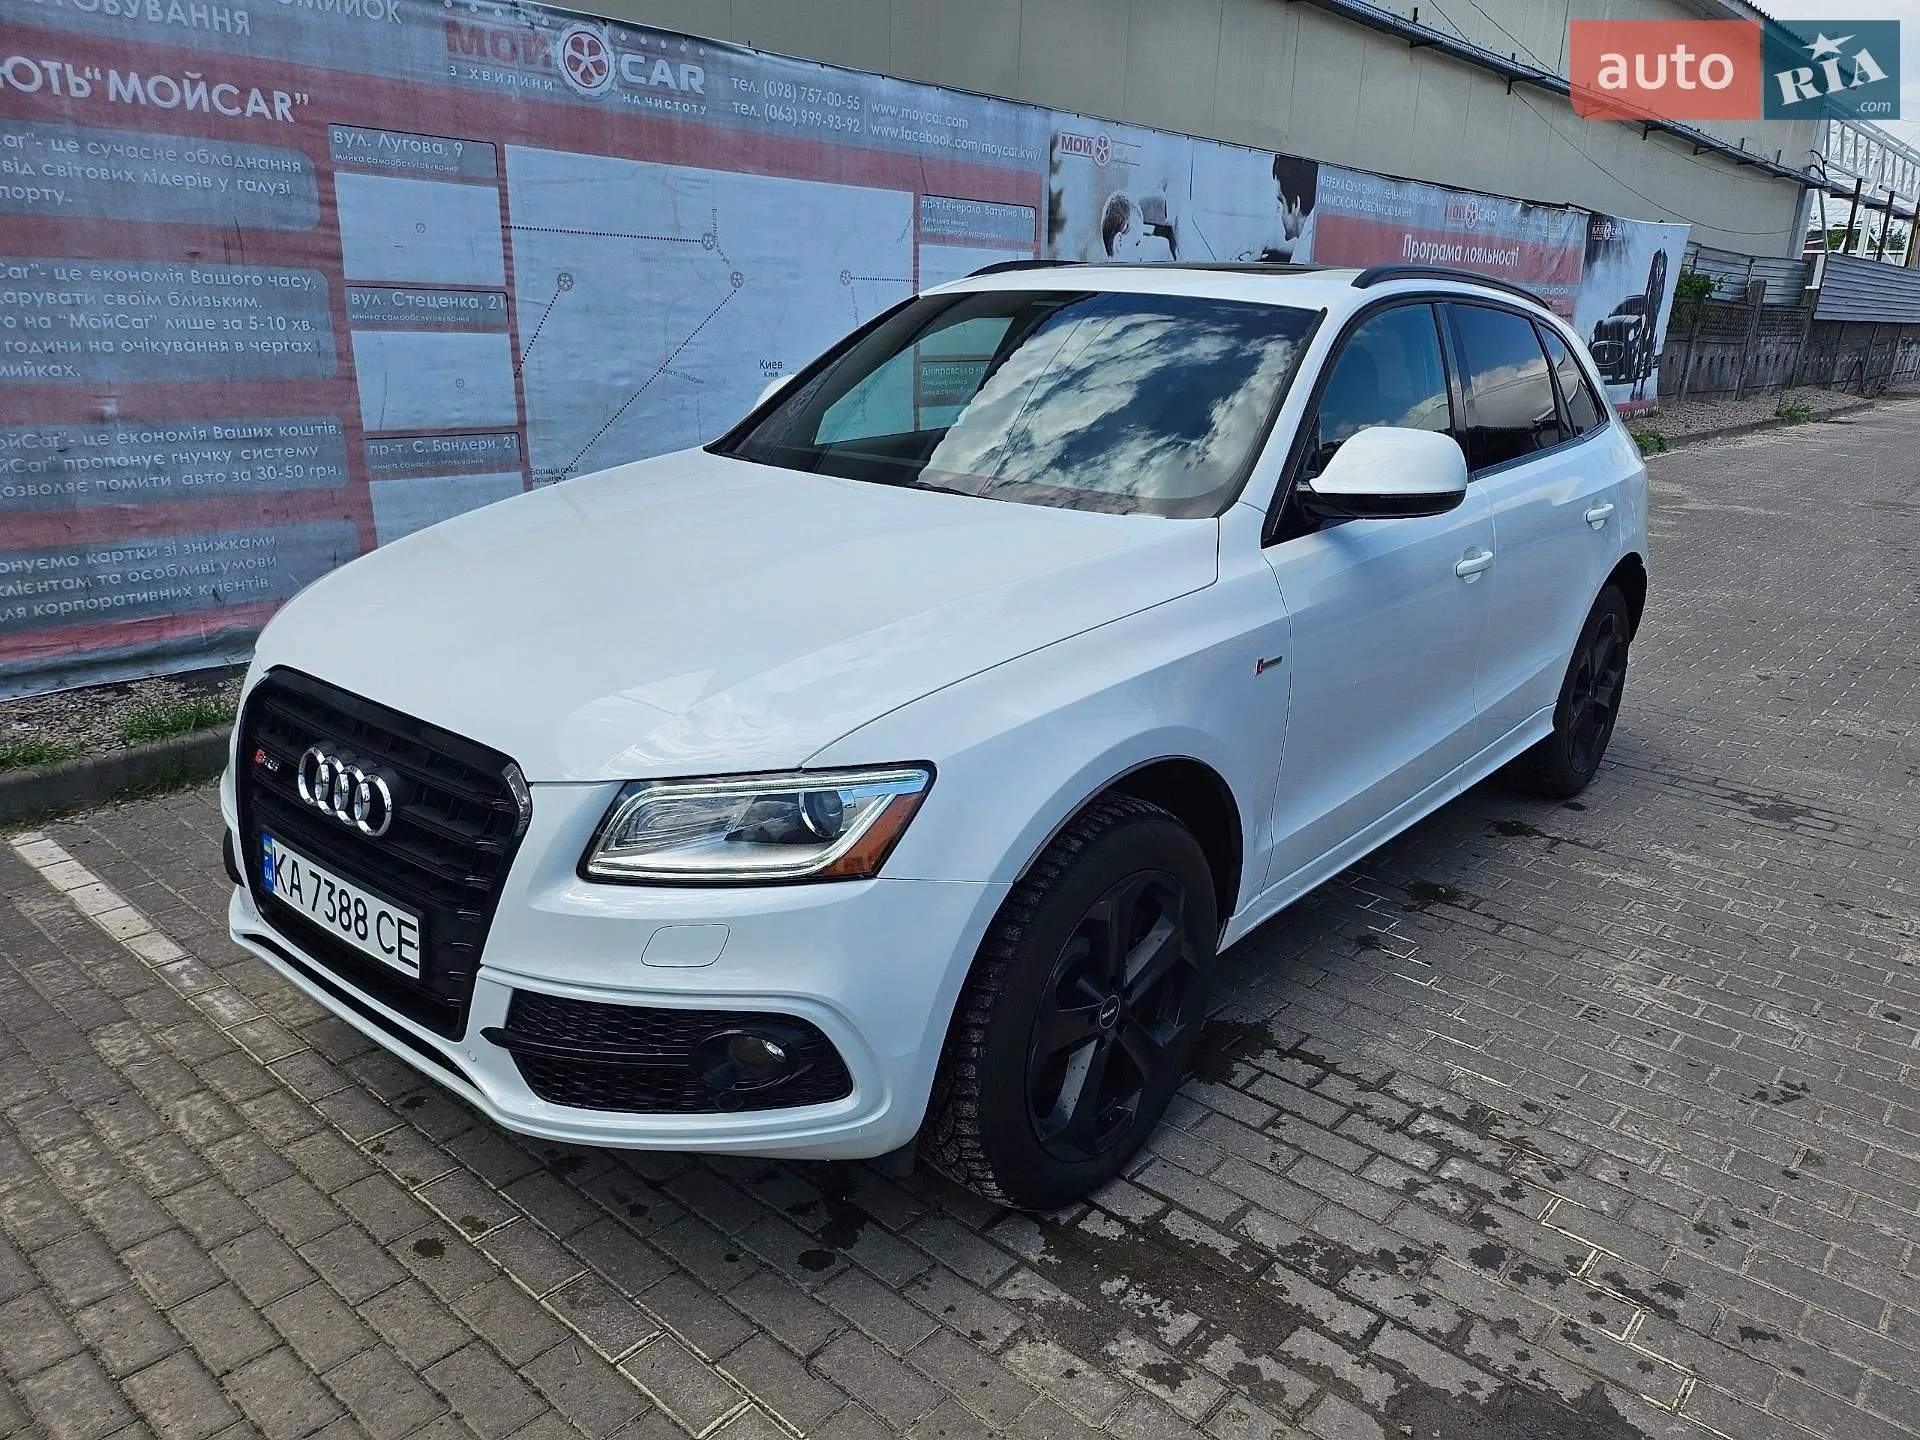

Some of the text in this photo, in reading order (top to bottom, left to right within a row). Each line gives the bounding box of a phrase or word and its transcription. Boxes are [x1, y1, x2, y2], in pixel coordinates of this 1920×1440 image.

[470, 69, 553, 92] ХВИЛИНИ
[620, 53, 706, 95] CAR
[622, 93, 708, 115] НА ЧИСТОТУ
[731, 77, 861, 111] тел. (098) 757-00-55
[732, 101, 861, 134] тел. (063) 999-93-92
[50, 139, 80, 154] це
[87, 141, 178, 162] сучасне
[184, 149, 302, 174] обладнання
[333, 131, 464, 158] вул. Лугова, 9
[335, 153, 365, 164] мийка
[2, 157, 291, 197] від світових лідерів у галузі
[1402, 233, 1520, 266] Програма лояльності
[54, 267, 83, 283] це
[90, 268, 184, 285] економія
[190, 269, 263, 288] Вашого
[268, 277, 317, 291] часу,
[0, 290, 263, 308] арувати своїм близьким.
[351, 291, 505, 310] вул. Стеценка, 21
[25, 316, 52, 328] на
[165, 316, 217, 330] лише
[223, 318, 243, 330] за
[249, 316, 287, 331] 5-10
[292, 320, 316, 331] хв.
[4, 337, 313, 356] години на очікування в чергах
[759, 359, 783, 370] Киев
[83, 434, 110, 447] це
[117, 427, 207, 445] економія
[213, 426, 274, 440] Ваших
[279, 421, 342, 437] коштів.
[412, 440, 429, 454] С.
[433, 438, 500, 452] Бандери,
[503, 435, 517, 449] 21
[63, 453, 166, 473] пропонує
[171, 450, 232, 467] гнучку
[240, 446, 319, 460] систему
[0, 464, 342, 500] озволяє помити авто за 30-50 грн.
[86, 546, 158, 566] картки
[164, 541, 177, 557] зі
[184, 535, 276, 555] знижками
[97, 573, 121, 587] та
[128, 559, 215, 582] особливі
[220, 556, 277, 575] умови
[34, 586, 194, 616] корпоративних
[198, 575, 274, 596] клієнтів.
[273, 846, 419, 971] KA 7388 CE
